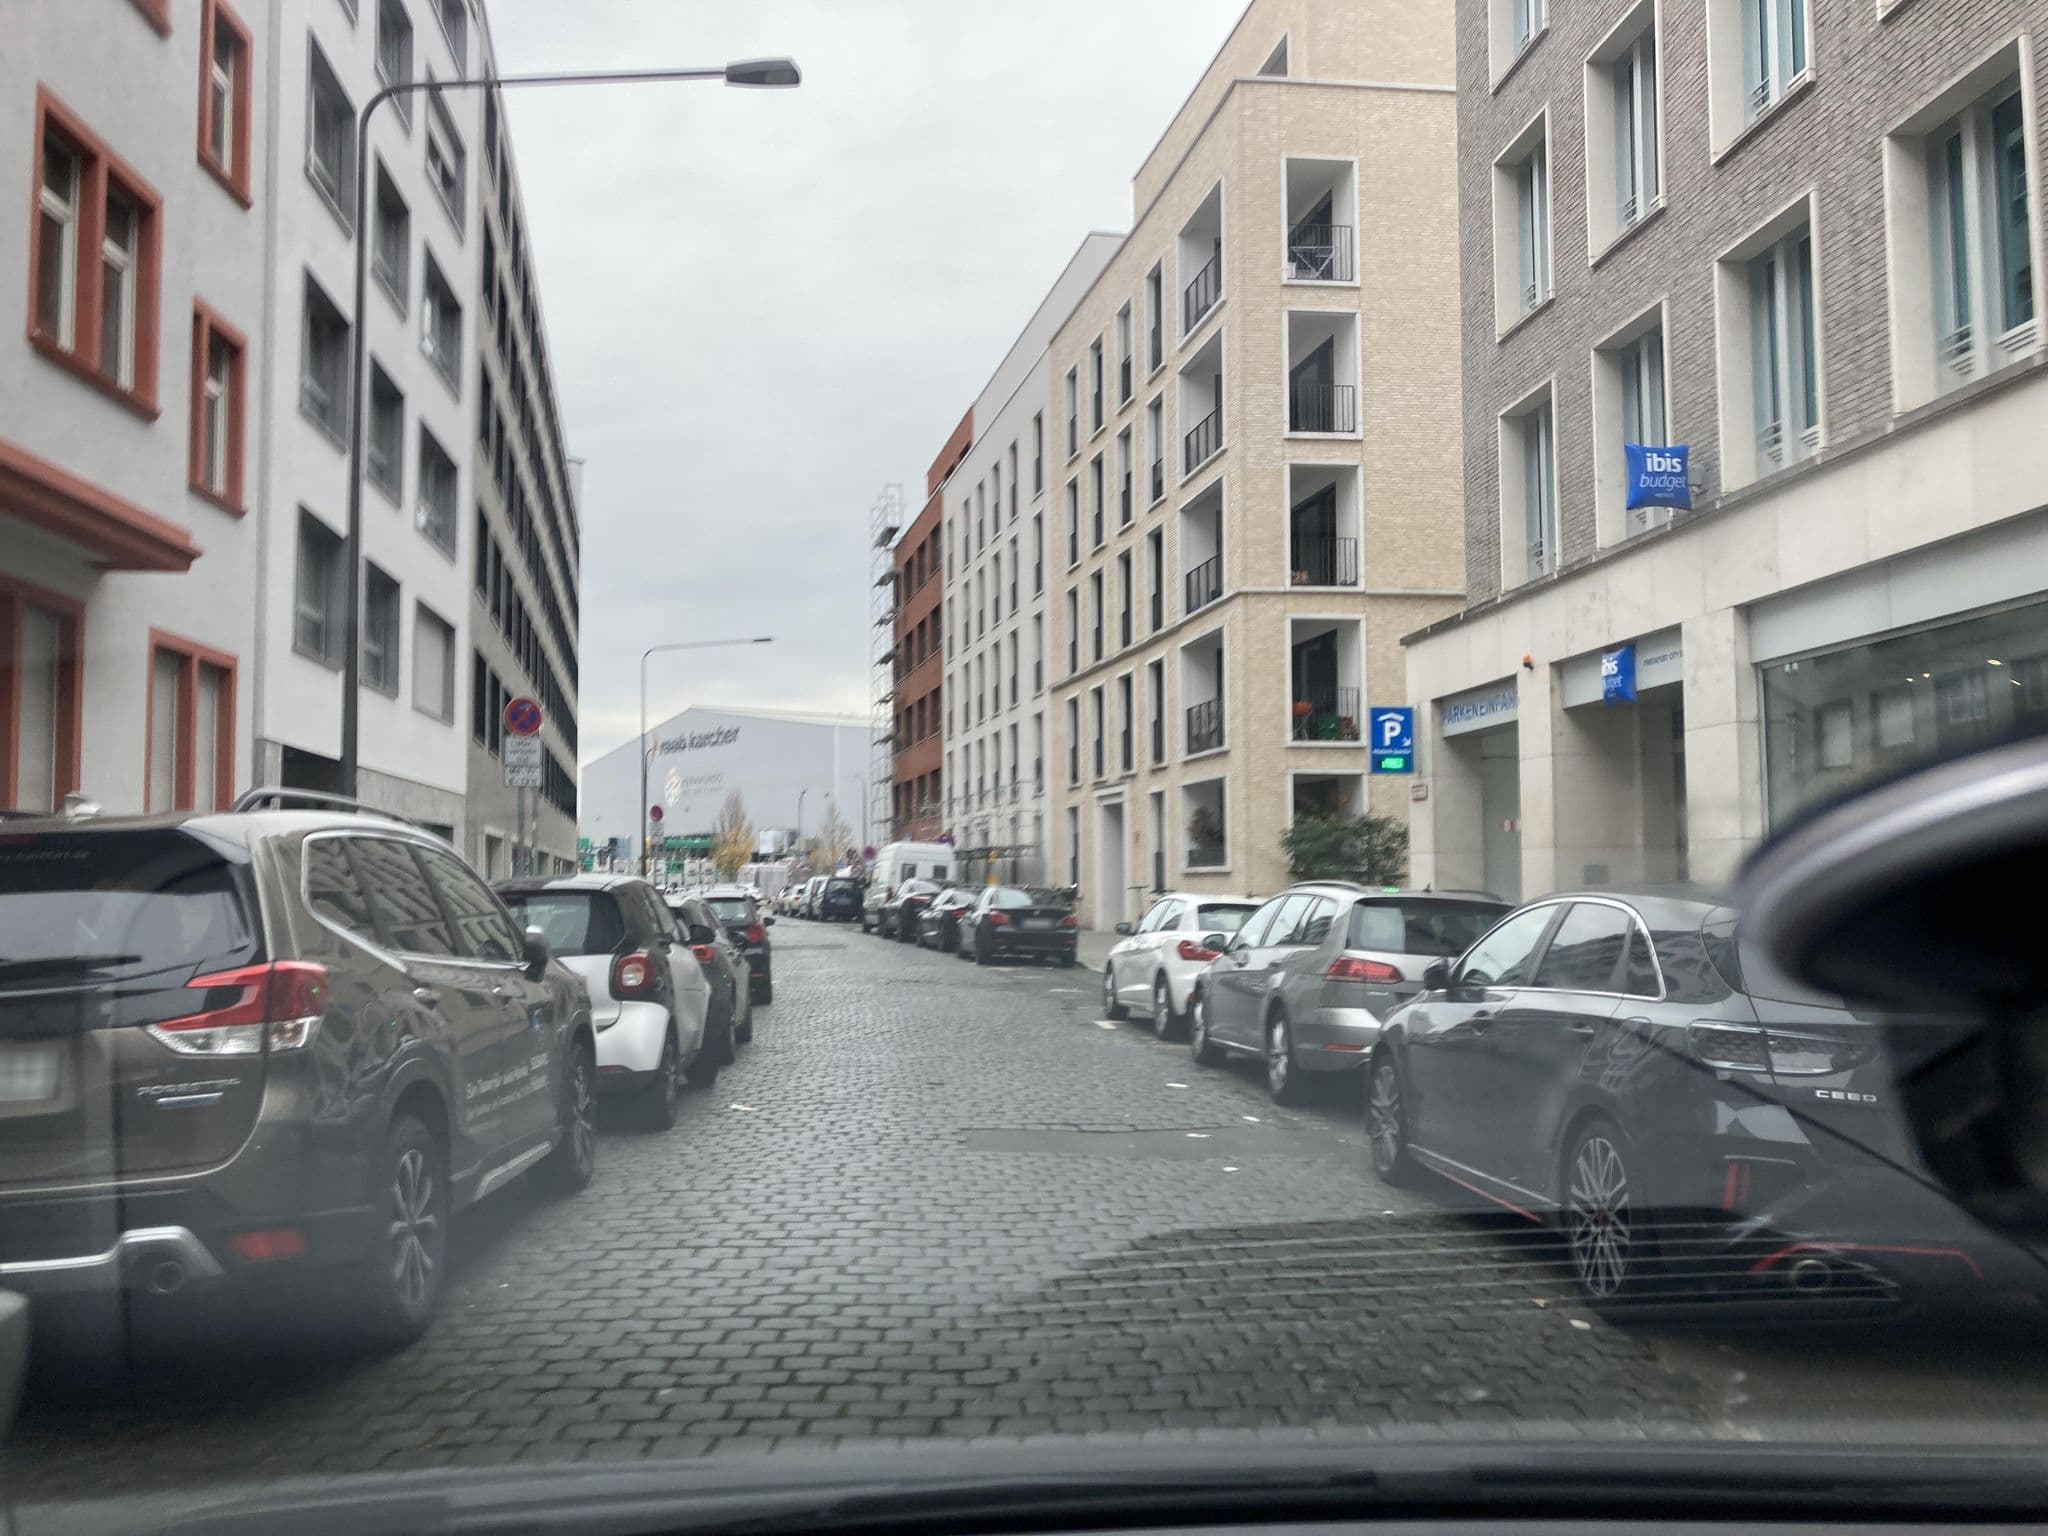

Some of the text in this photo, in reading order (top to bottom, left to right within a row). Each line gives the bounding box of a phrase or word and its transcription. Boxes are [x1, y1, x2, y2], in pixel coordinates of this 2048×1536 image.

[1646, 453, 1682, 473] ibis
[1640, 473, 1687, 491] budget
[1383, 720, 1402, 747] P
